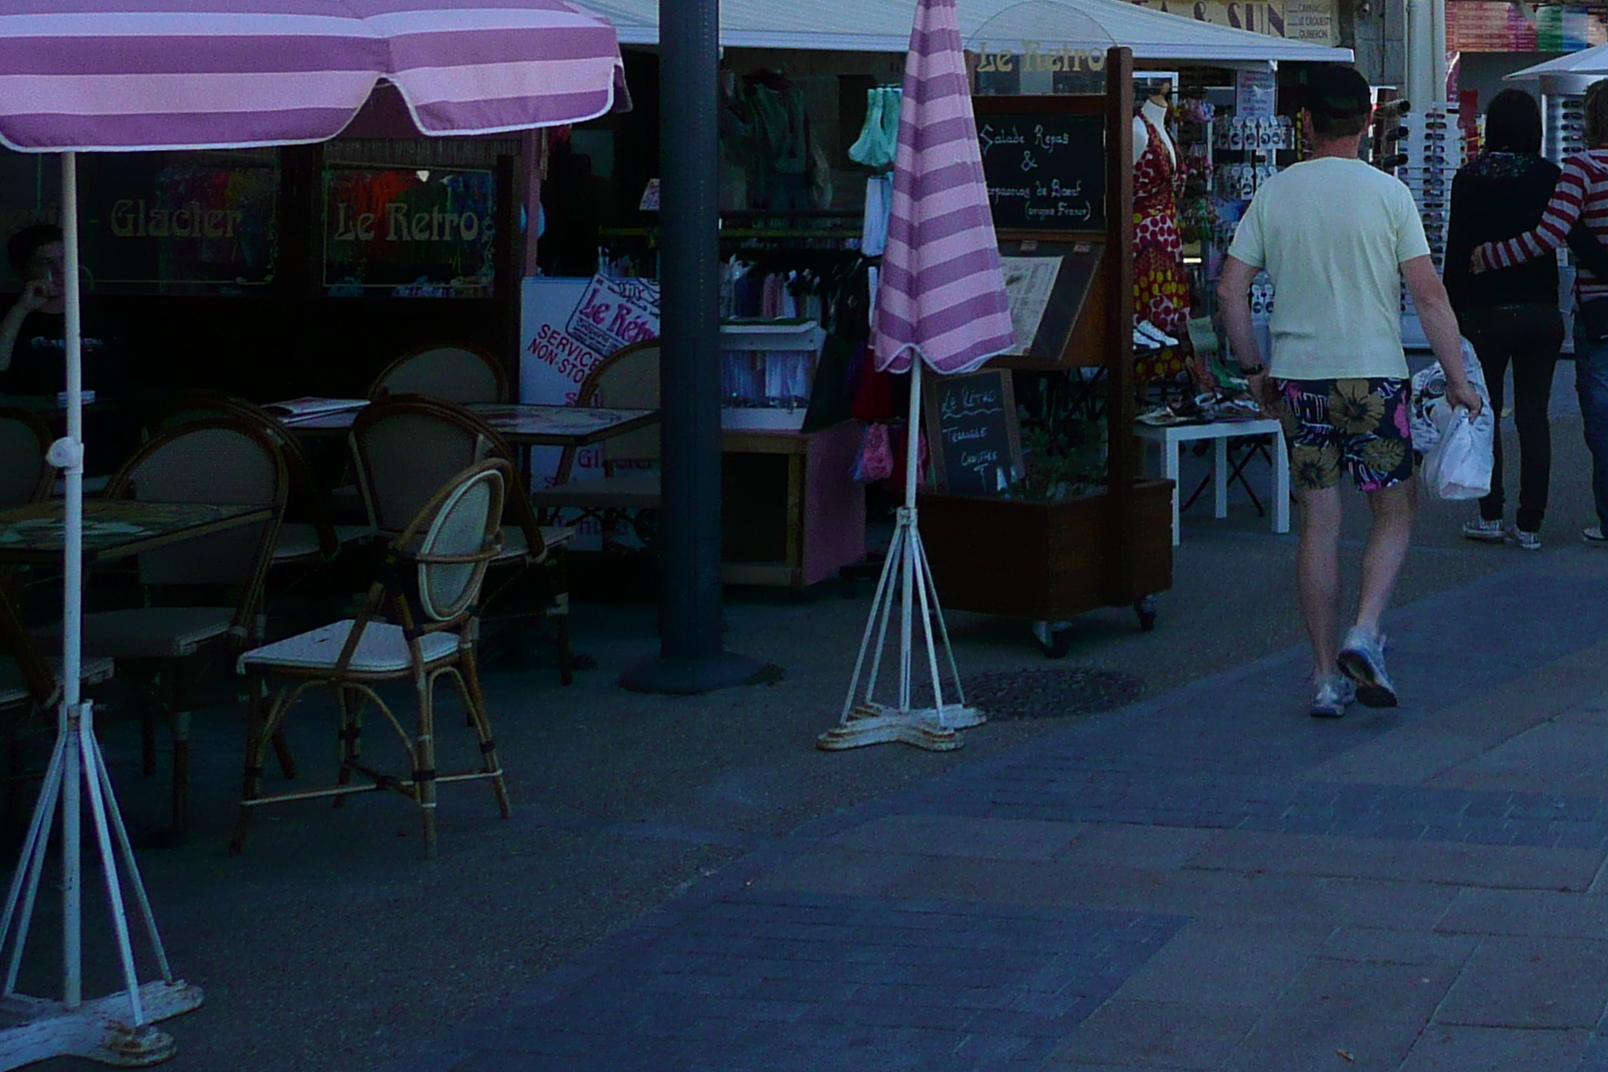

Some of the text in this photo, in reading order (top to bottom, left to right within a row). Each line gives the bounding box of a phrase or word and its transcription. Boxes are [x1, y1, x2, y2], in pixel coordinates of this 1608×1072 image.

[976, 42, 1013, 72] Le
[979, 123, 1026, 157] Salade
[1020, 150, 1038, 172] &
[110, 198, 243, 238] Glacier
[333, 202, 376, 241] Le
[579, 287, 611, 325] Le
[538, 324, 604, 372] SERVICE
